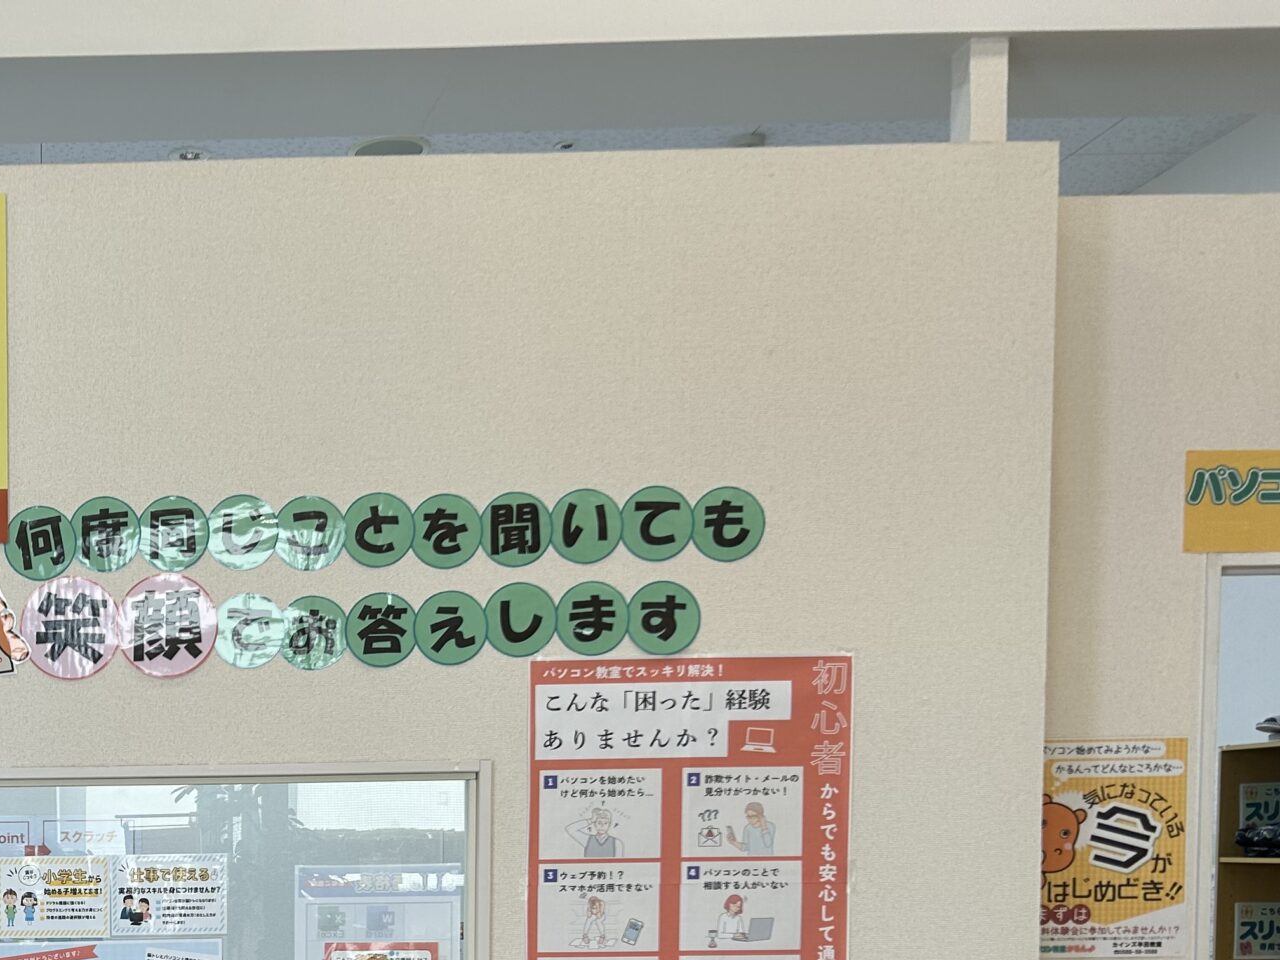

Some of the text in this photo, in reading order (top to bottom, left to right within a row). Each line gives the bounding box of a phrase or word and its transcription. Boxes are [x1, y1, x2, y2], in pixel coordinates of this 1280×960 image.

[15, 499, 753, 569] 何度同じことを聞いても
[33, 578, 688, 661] 笑顔でお答えします
[542, 663, 725, 680] パソコン教室でスッキリ解決！
[545, 688, 771, 714] こんな「困った」経験
[543, 727, 719, 751] ありませんか？
[559, 776, 646, 786] パソコンを始めたい
[703, 787, 788, 797] 見分けがつかない！
[1083, 782, 1186, 839] 気になっている
[702, 867, 780, 878] パソコンのことで
[1151, 853, 1173, 874] が
[128, 866, 210, 883] 仕事で使える
[558, 882, 654, 893] スマホが活用できない
[702, 879, 789, 890] 相談する人がいない
[1240, 919, 1280, 941] スリ
